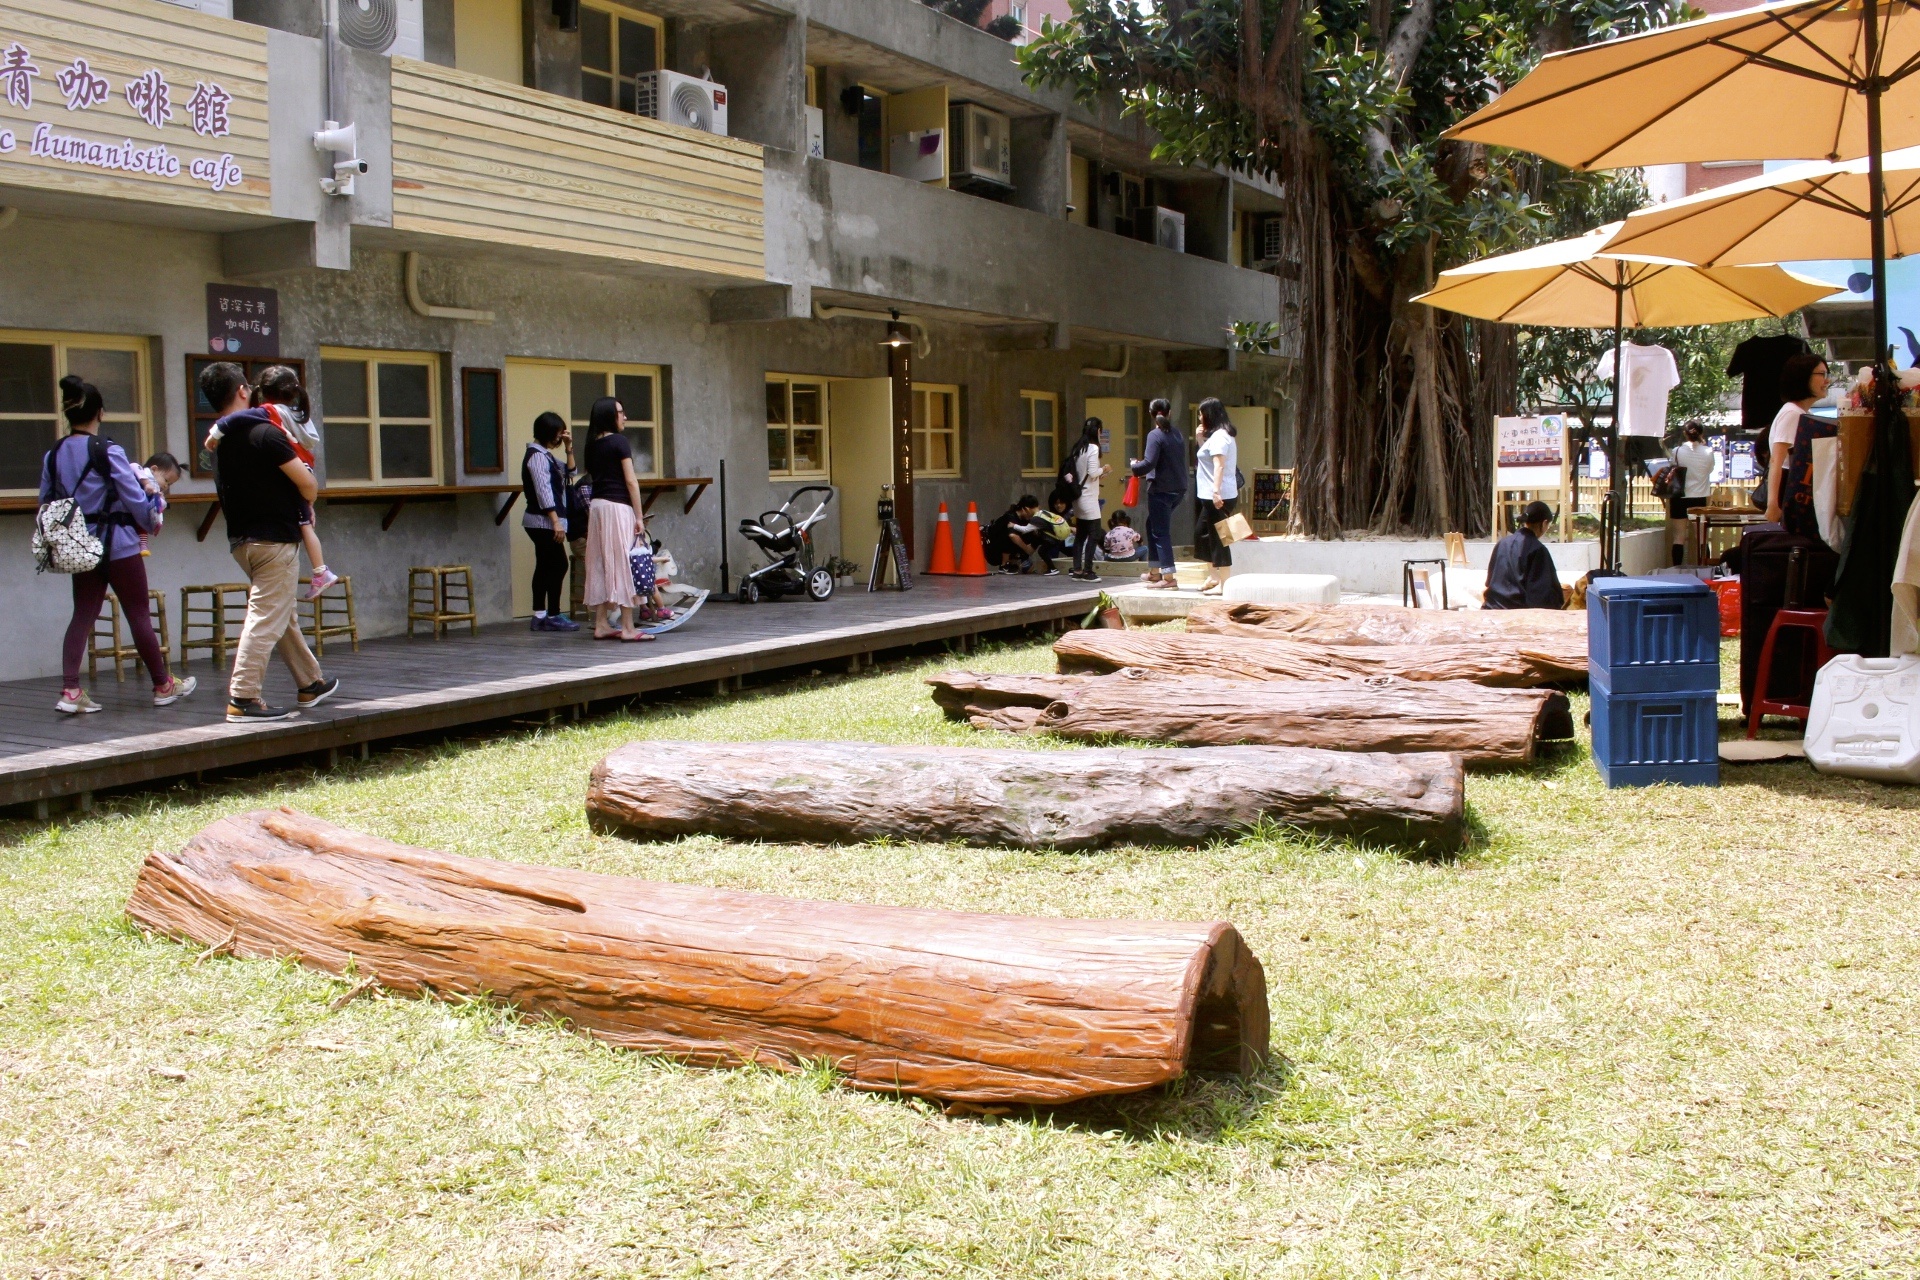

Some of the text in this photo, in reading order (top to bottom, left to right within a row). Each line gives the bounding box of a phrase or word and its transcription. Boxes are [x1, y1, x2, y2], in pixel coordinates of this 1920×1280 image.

[0, 44, 231, 136] 青咖啡館
[35, 126, 178, 173] humanistic
[192, 156, 240, 188] cafe
[219, 298, 266, 315] 資深文青
[225, 319, 260, 333] 咖啡店
